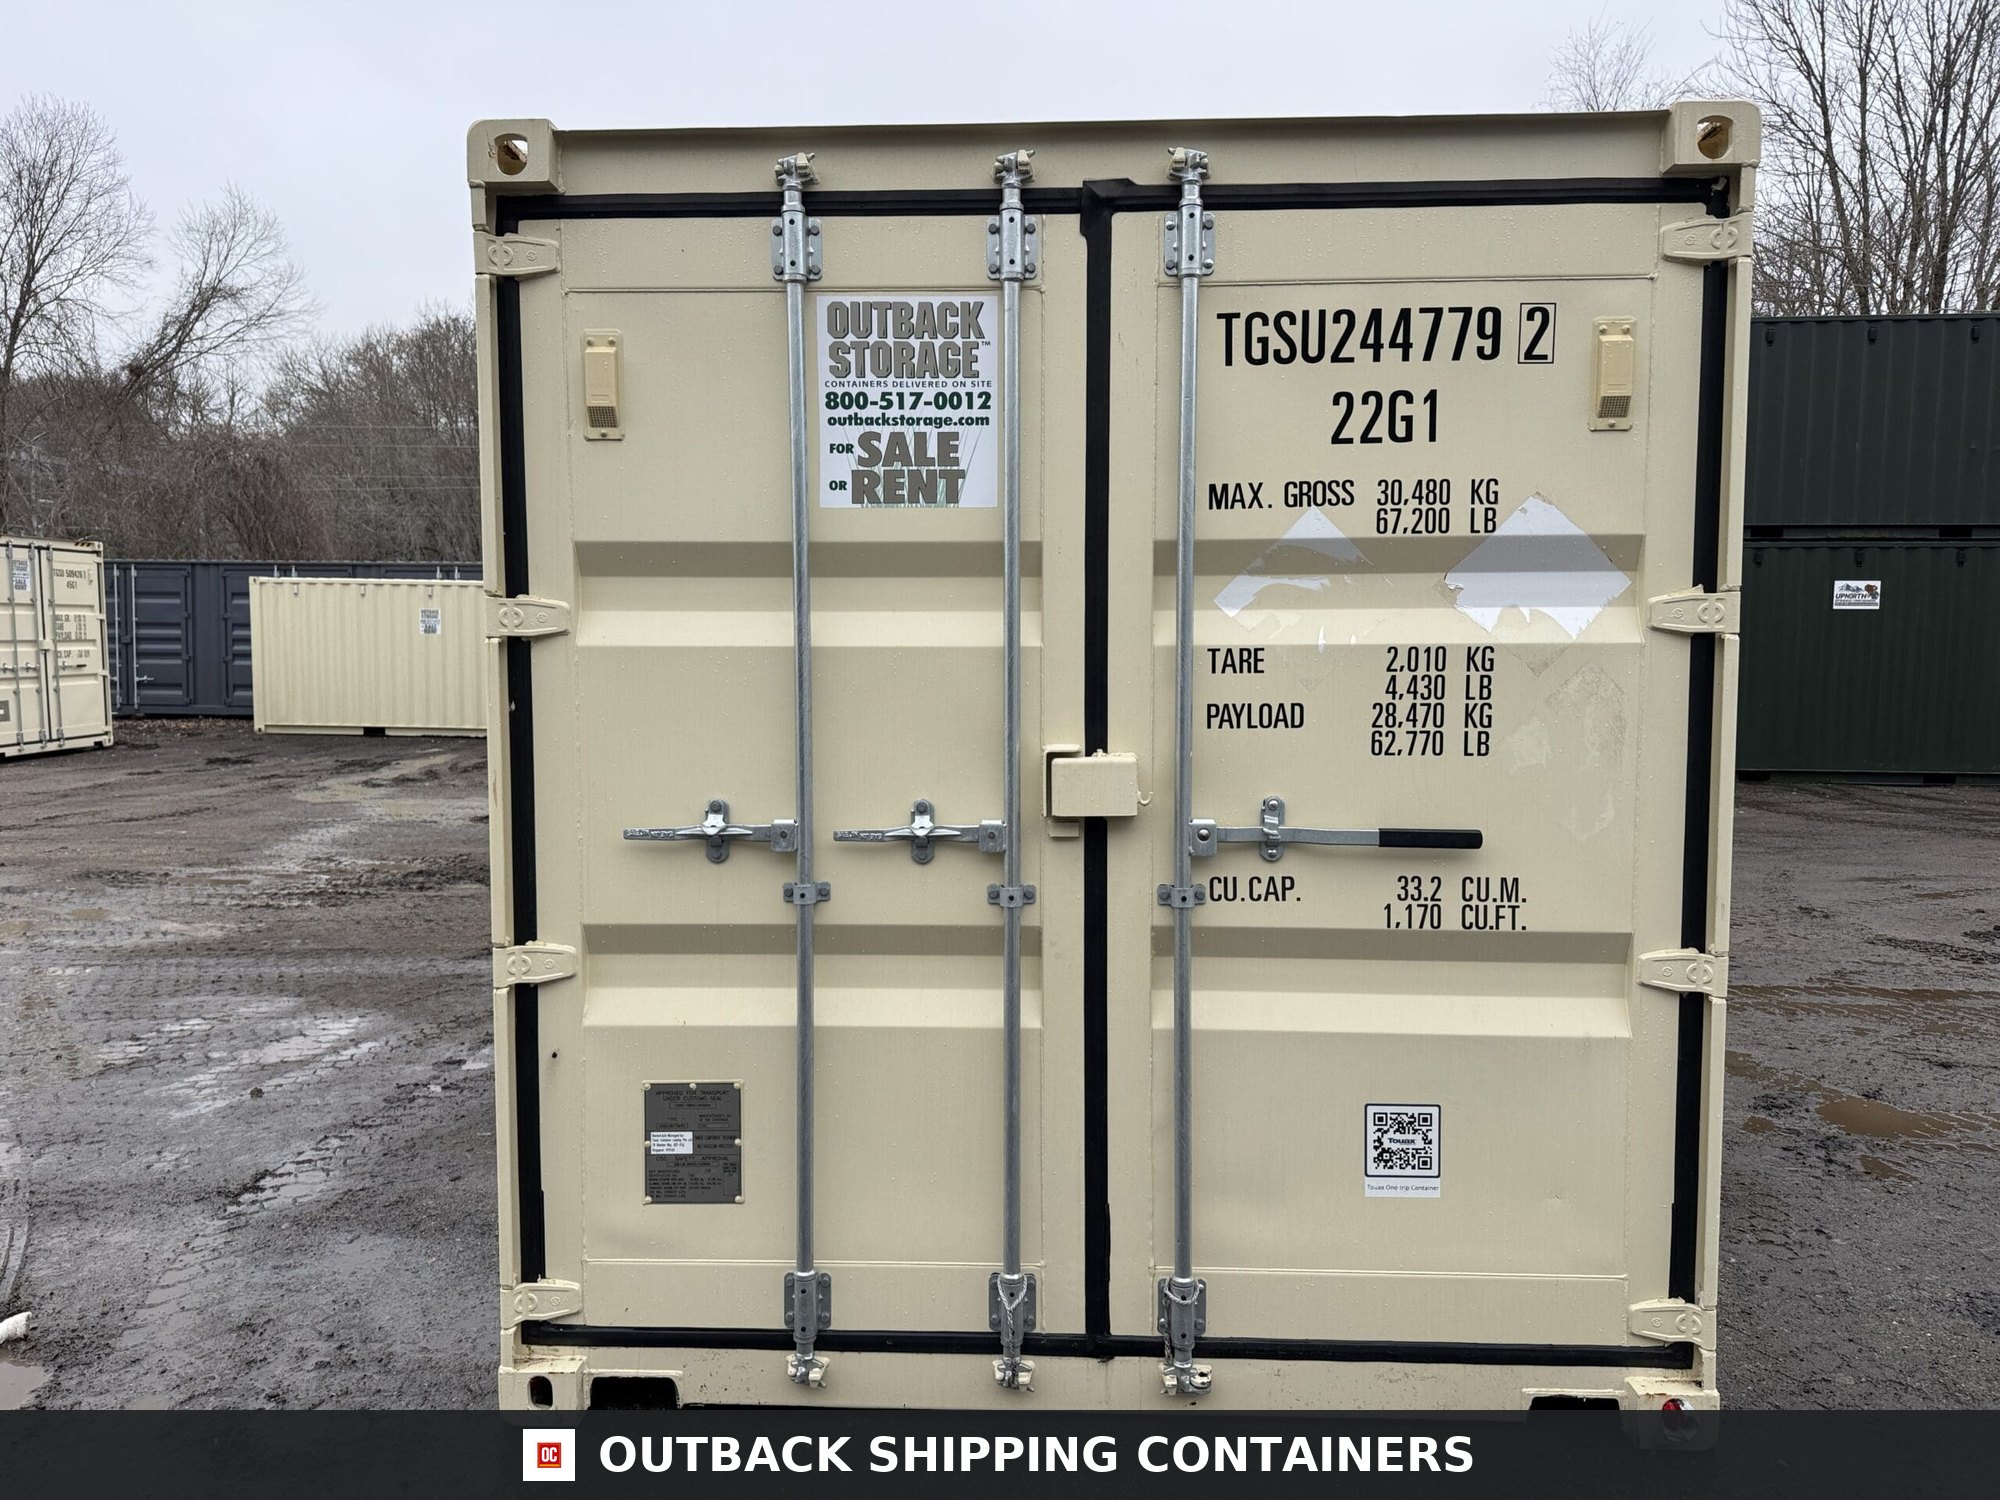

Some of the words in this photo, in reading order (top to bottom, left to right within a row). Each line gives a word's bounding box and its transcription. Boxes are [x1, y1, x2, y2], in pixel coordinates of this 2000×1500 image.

[827, 301, 985, 339] OUTBACK
[1217, 307, 1501, 366] TGSU244779
[1523, 306, 1550, 361] 2
[829, 341, 979, 379] STORAGE
[825, 391, 991, 410] 800-517-0012
[828, 412, 989, 429] outbackstorage.com
[1331, 389, 1437, 444] 22G1
[830, 444, 854, 454] FOR
[857, 431, 959, 467] SALE
[829, 481, 847, 490] OR
[851, 469, 966, 504] RENT
[1209, 483, 1272, 510] MAX.
[1285, 480, 1354, 507] GROSS
[1377, 479, 1450, 506] 30,480
[1471, 479, 1498, 504] KG
[1377, 508, 1449, 534] 67,200
[1471, 507, 1496, 533] LB
[1207, 648, 1264, 674] TARE
[1387, 646, 1446, 672] 2,010
[1467, 646, 1494, 672] KG
[1385, 674, 1445, 700] 4,430
[1466, 675, 1491, 700] LB
[1207, 703, 1304, 729] PAYLOAD
[1372, 702, 1444, 728] 28,470
[1465, 703, 1492, 728] KG
[1372, 730, 1443, 756] 62,770
[1464, 731, 1489, 756] LB
[1397, 876, 1441, 901] 33.2
[1462, 877, 1526, 902] CU.M.
[1384, 904, 1441, 929] 1,170
[1462, 904, 1526, 930] CU.FT.
